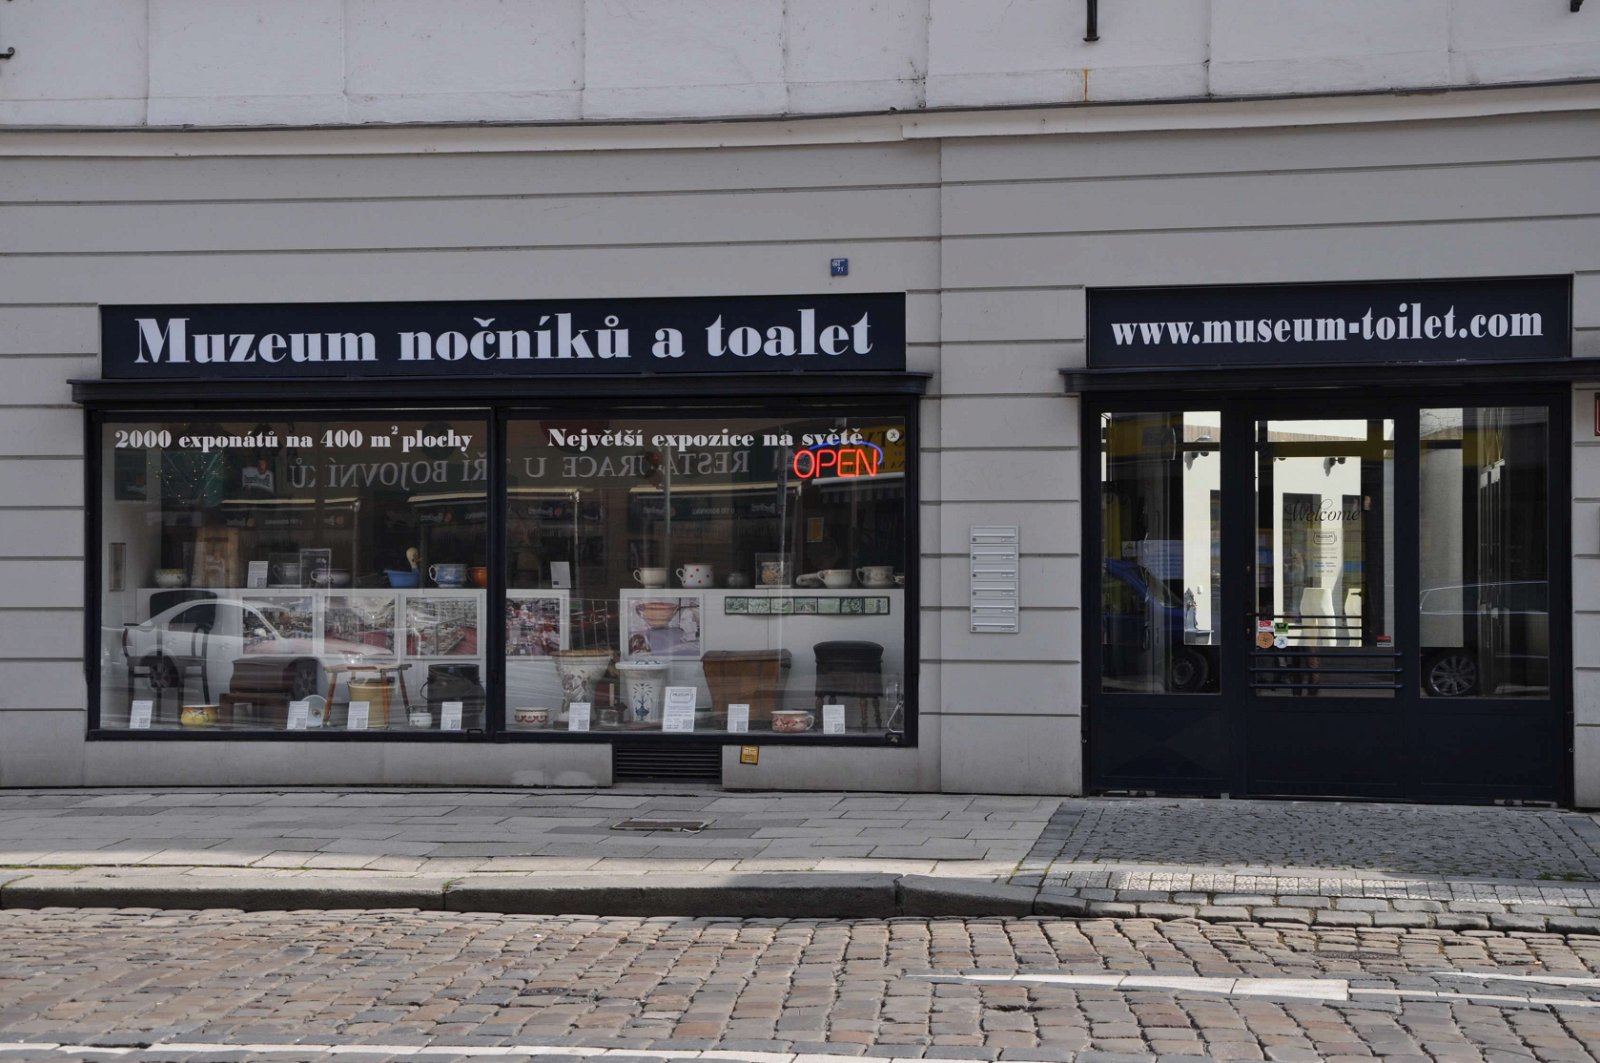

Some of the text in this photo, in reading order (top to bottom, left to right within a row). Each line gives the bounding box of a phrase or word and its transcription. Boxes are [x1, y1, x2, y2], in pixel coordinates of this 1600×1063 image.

[134, 308, 873, 364] Muzeum nočníků a toalet
[1111, 302, 1544, 346] www.museum-toilet.com
[115, 430, 172, 448] 2000
[178, 430, 278, 453] exponátů
[286, 435, 313, 448] na
[320, 429, 363, 448] 400
[402, 429, 473, 453] plochy
[548, 428, 644, 452] Největší
[651, 428, 755, 452] expozice
[763, 434, 794, 447] na
[802, 428, 863, 446] světě
[793, 449, 878, 479] OPEN
[1285, 498, 1361, 522] Welcome
